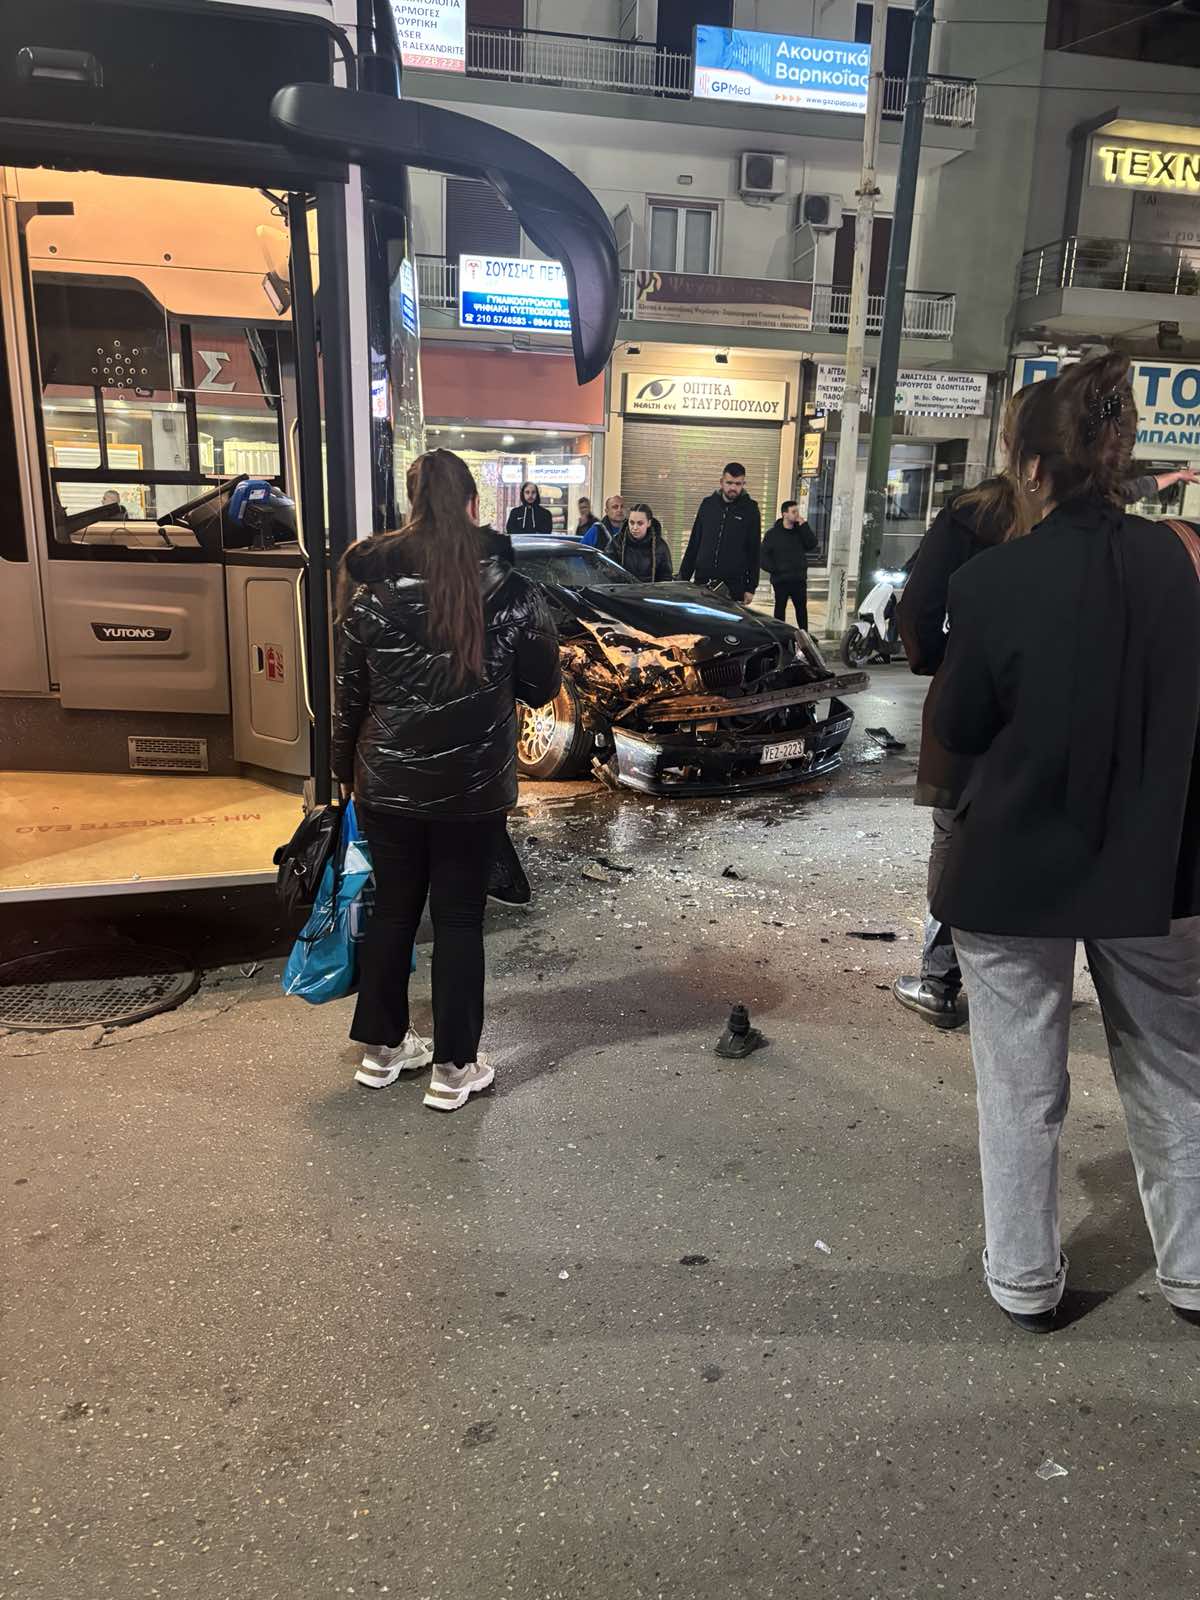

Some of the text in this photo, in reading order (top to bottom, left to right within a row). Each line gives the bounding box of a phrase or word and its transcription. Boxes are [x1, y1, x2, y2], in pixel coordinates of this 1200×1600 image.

[394, 5, 440, 17] ΑΡΜΟΓΕΣ
[396, 17, 437, 29] ΟΥΡΓΙΚΗ
[399, 30, 421, 39] ASER
[410, 42, 465, 55] ALEXANDRITE
[776, 41, 869, 66] Ακουστικά
[711, 81, 751, 95] GPMed
[486, 261, 535, 279] ΣΟΥΣΣΗΣ
[476, 314, 491, 322] 210
[197, 351, 235, 391] Σ
[900, 373, 937, 381] ΑΝΑΣΤΑΣΙΑ
[683, 382, 732, 396] ΟΠΤΙΚΑ
[936, 383, 982, 392] ΟΔΟΝΤΙΑΤΡΟΣ
[683, 397, 780, 414] ΣΤΑΥΡΟΠΟΥΛΟΥ
[103, 628, 155, 638] YUTONG
[765, 742, 802, 760] YEZ-2223
